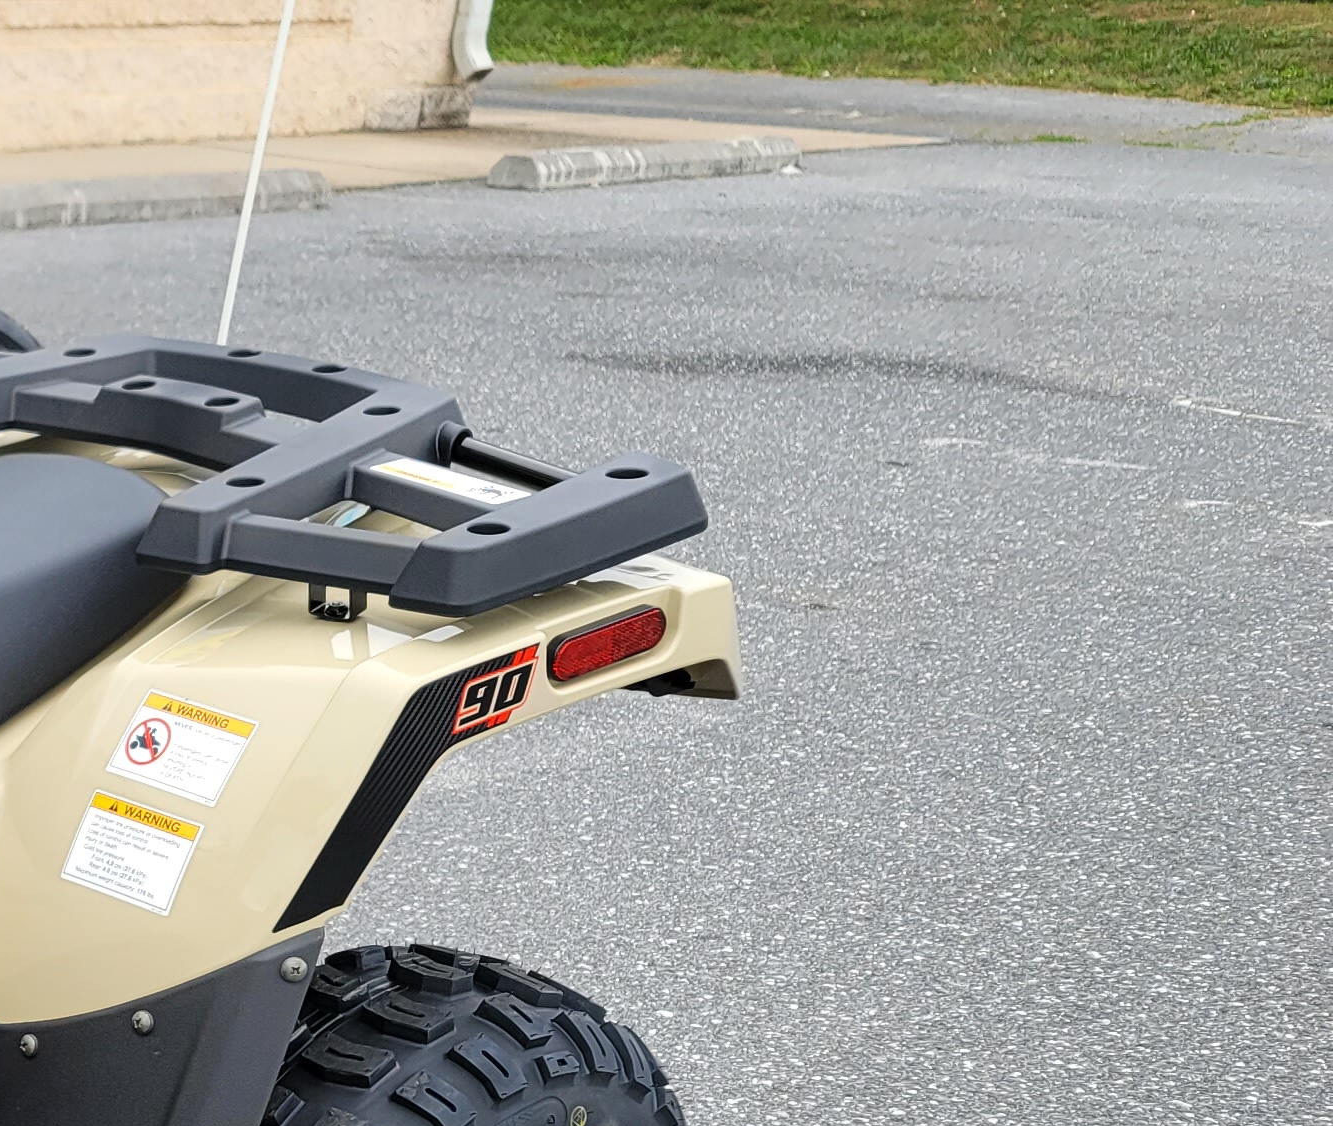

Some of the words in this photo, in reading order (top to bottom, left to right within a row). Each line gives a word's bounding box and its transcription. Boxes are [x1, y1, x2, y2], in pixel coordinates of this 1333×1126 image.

[458, 661, 534, 727] 90
[174, 703, 231, 729] WARNING
[124, 804, 181, 832] WARNING
